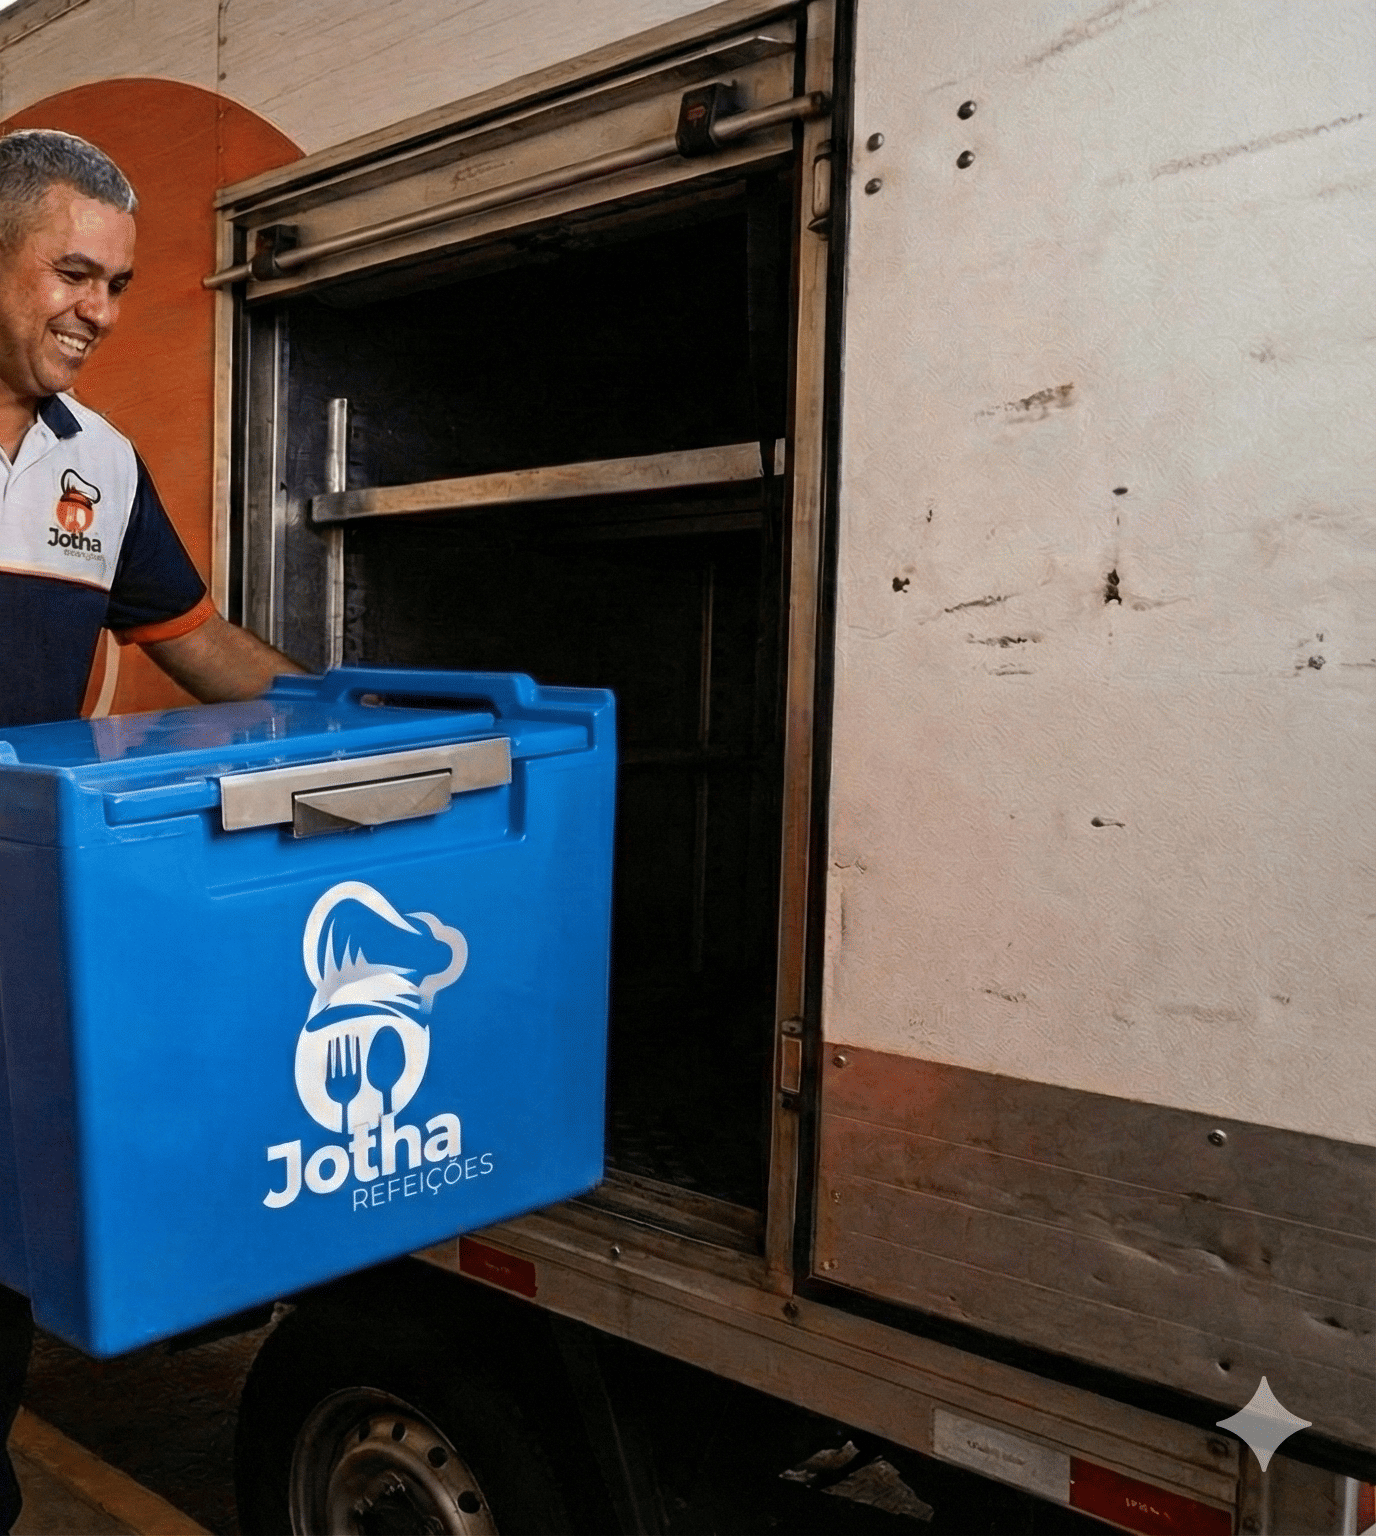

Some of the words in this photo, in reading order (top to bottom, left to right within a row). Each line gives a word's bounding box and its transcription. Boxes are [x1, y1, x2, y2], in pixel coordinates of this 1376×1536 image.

[48, 528, 101, 552] Jotha
[263, 1113, 462, 1208] Jotha
[353, 1153, 494, 1211] REFEIÇÕES
